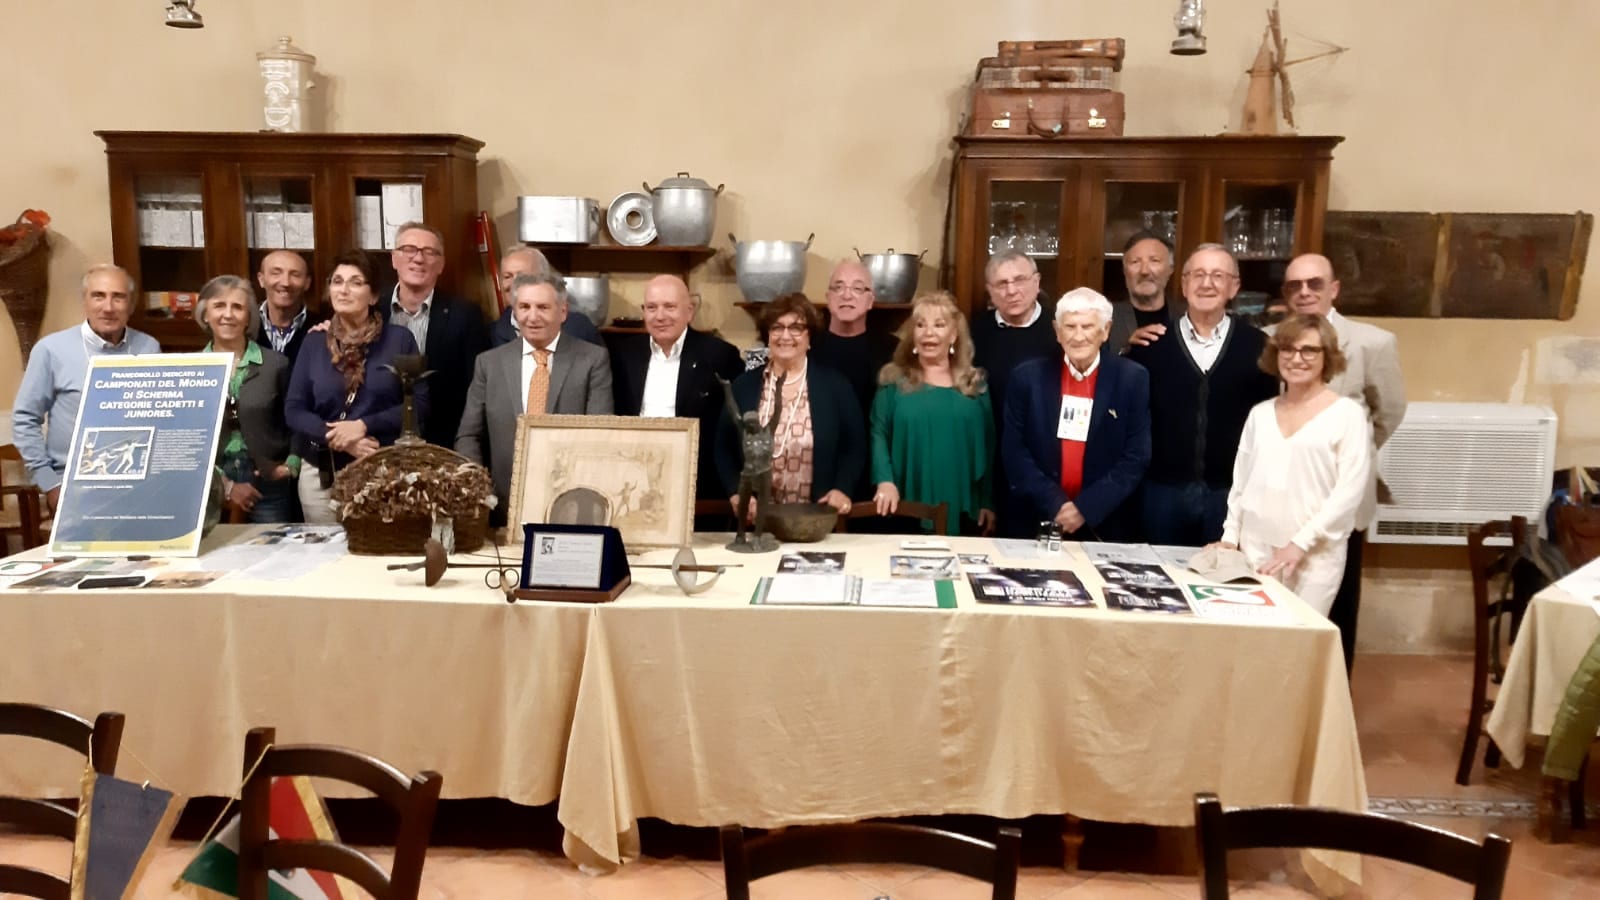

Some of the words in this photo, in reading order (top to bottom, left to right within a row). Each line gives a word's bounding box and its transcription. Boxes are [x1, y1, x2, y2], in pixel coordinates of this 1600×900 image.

[95, 380, 156, 389] CAMPIONATI
[158, 380, 176, 388] DEL
[179, 379, 218, 388] MONDO
[136, 390, 184, 399] SCHERMA
[99, 401, 152, 410] CATEGORIE
[155, 400, 196, 409] CADETTI
[198, 400, 205, 408] E
[124, 410, 175, 418] JUNIORES.
